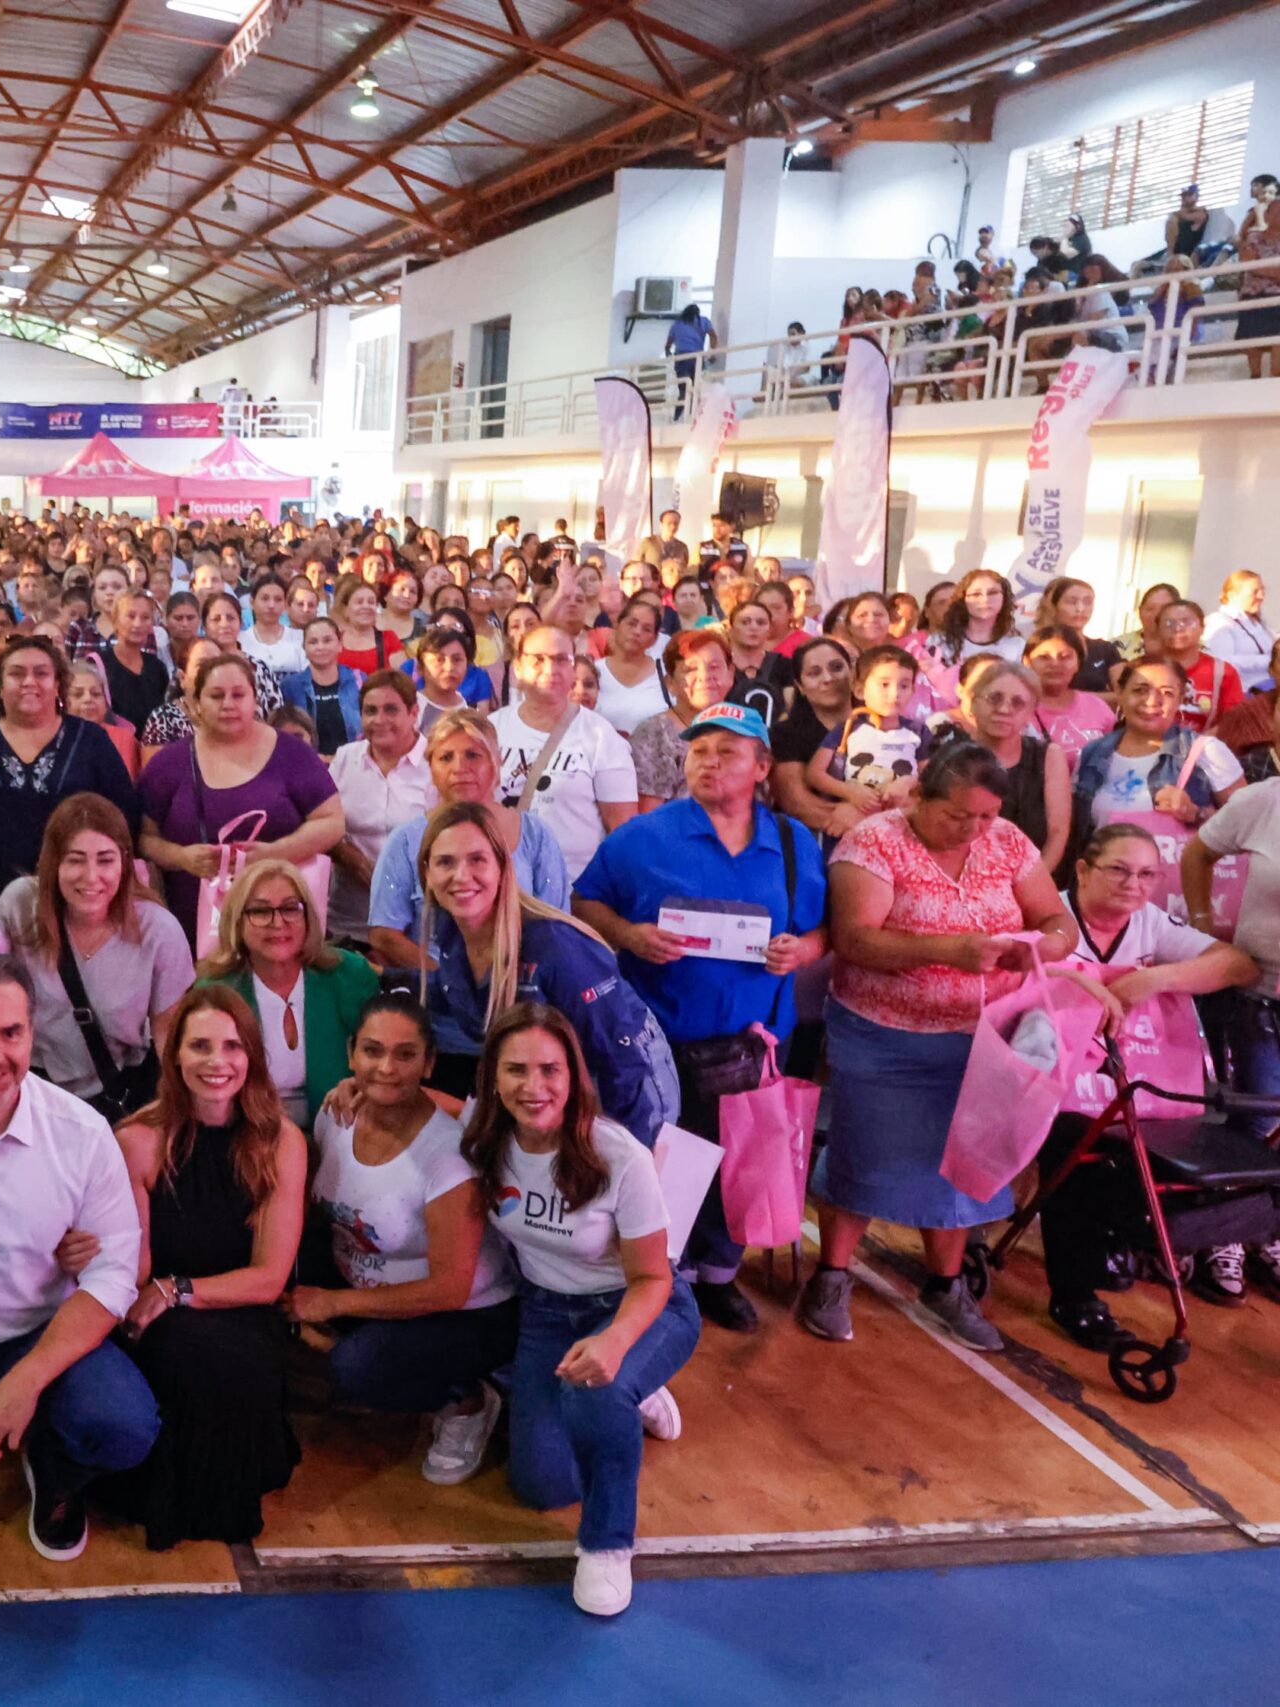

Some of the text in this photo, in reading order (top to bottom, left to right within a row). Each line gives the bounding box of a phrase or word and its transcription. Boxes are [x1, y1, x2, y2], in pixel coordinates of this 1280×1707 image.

[1027, 361, 1079, 470] Regia
[1029, 504, 1041, 526] SE
[1040, 489, 1060, 574] RESUELVE
